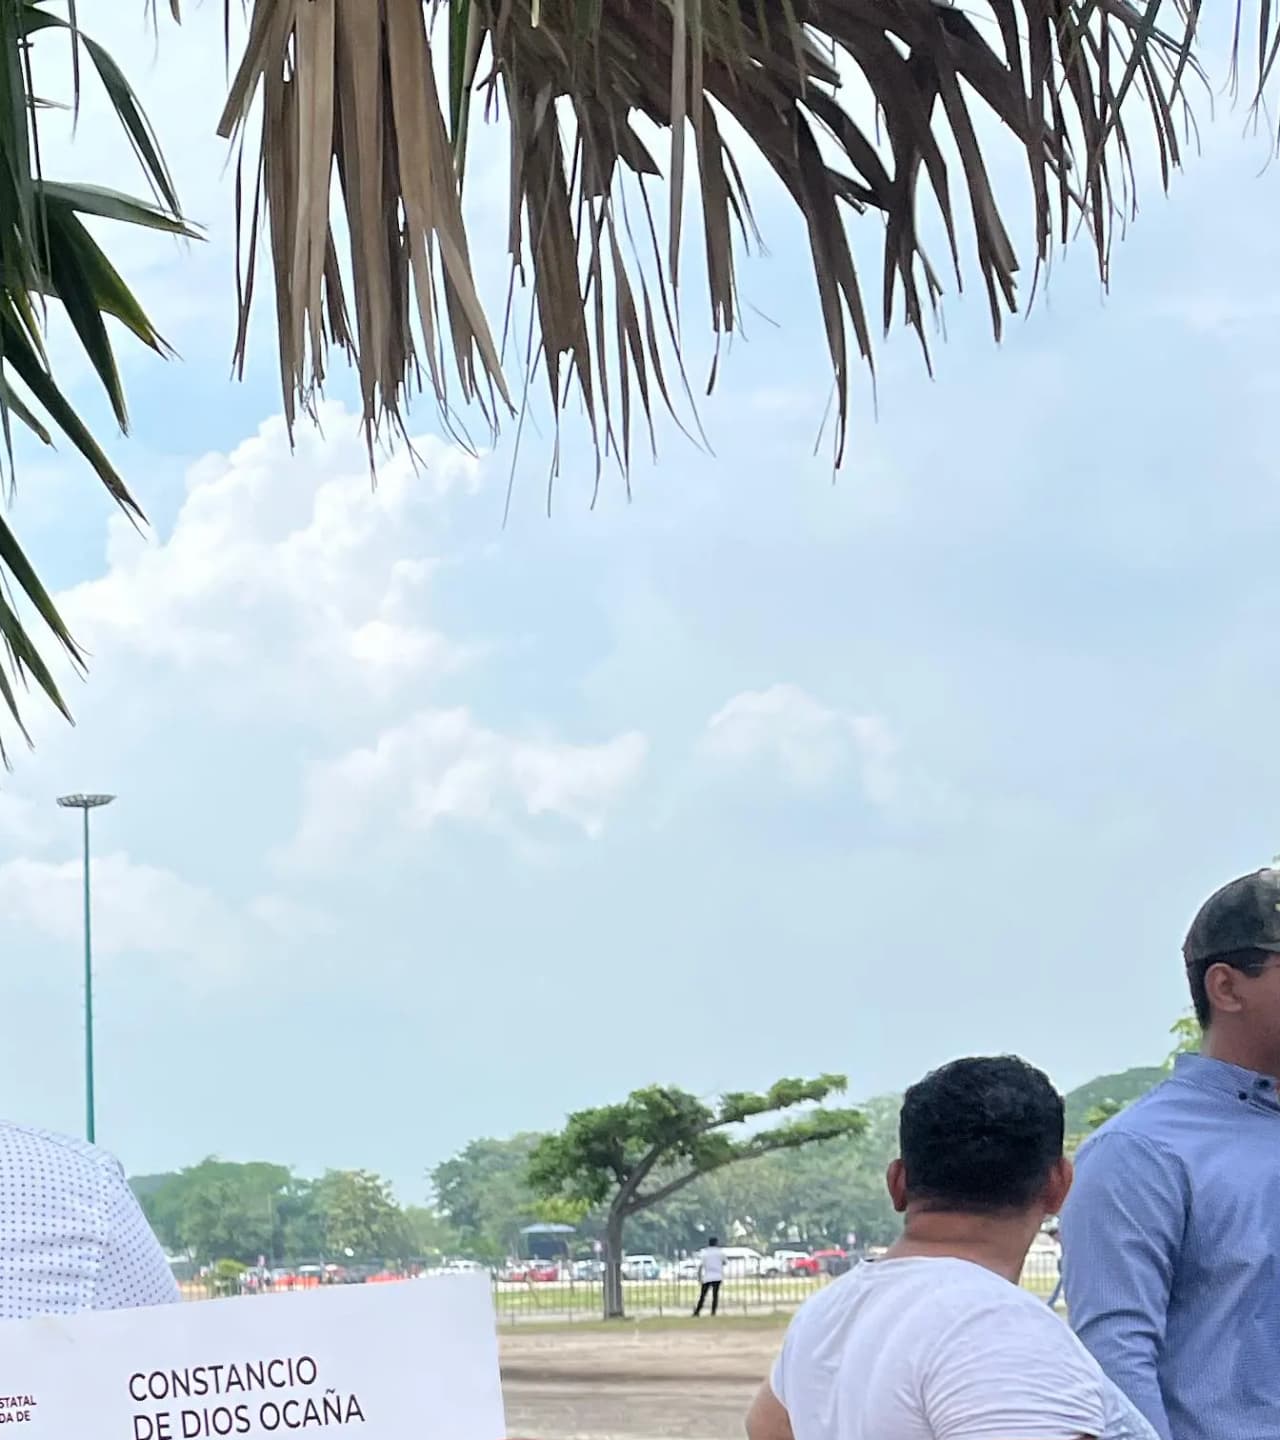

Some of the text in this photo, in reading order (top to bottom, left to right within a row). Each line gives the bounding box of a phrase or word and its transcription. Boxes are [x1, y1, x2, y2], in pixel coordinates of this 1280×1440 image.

[128, 1356, 317, 1401] CONSTANCIO
[16, 1410, 31, 1422] DE
[181, 1404, 251, 1439] DIOS
[259, 1388, 365, 1431] OCAÑA
